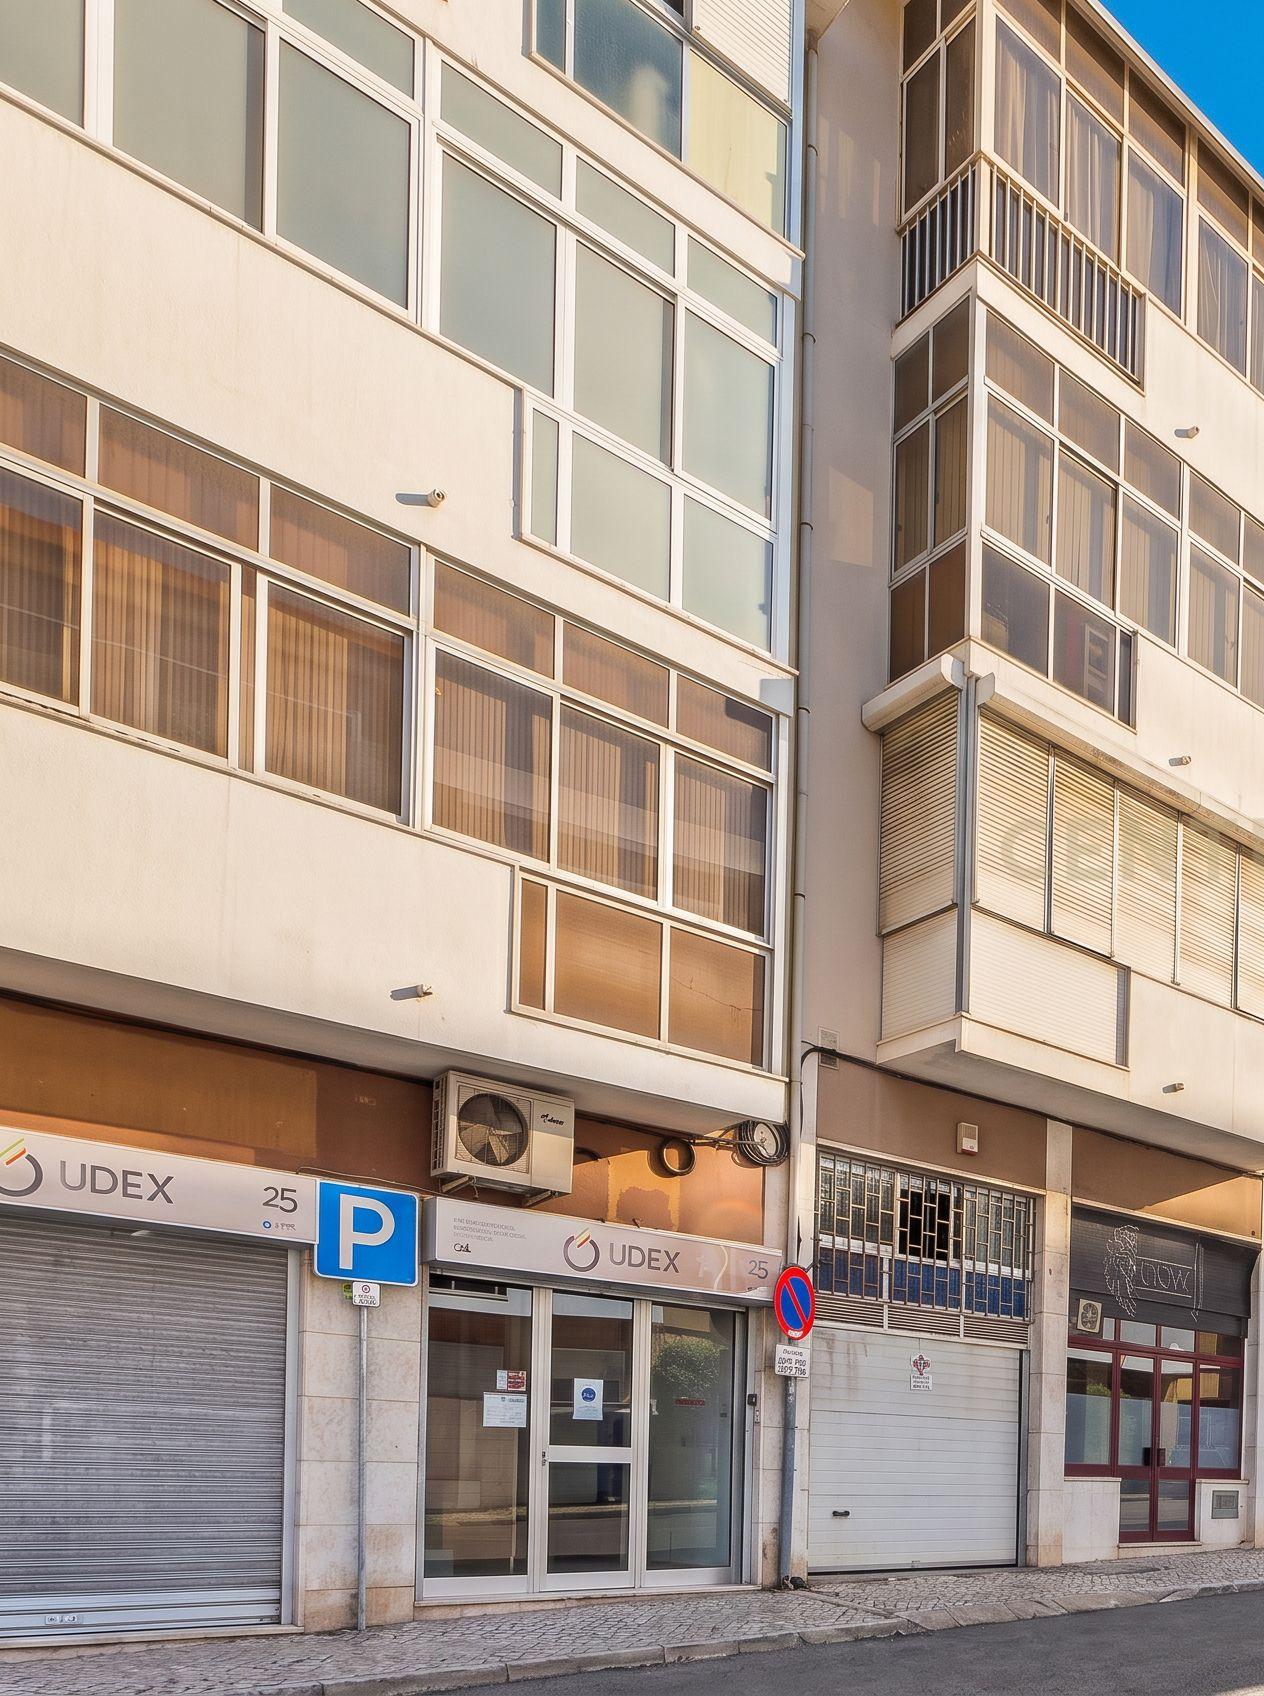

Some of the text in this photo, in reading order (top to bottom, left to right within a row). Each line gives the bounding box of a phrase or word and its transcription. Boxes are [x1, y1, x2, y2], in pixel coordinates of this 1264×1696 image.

[60, 1160, 174, 1204] UDEX
[262, 1186, 298, 1213] 25
[339, 1193, 395, 1270] P
[609, 1243, 681, 1274] UDEX
[748, 1260, 769, 1280] 25
